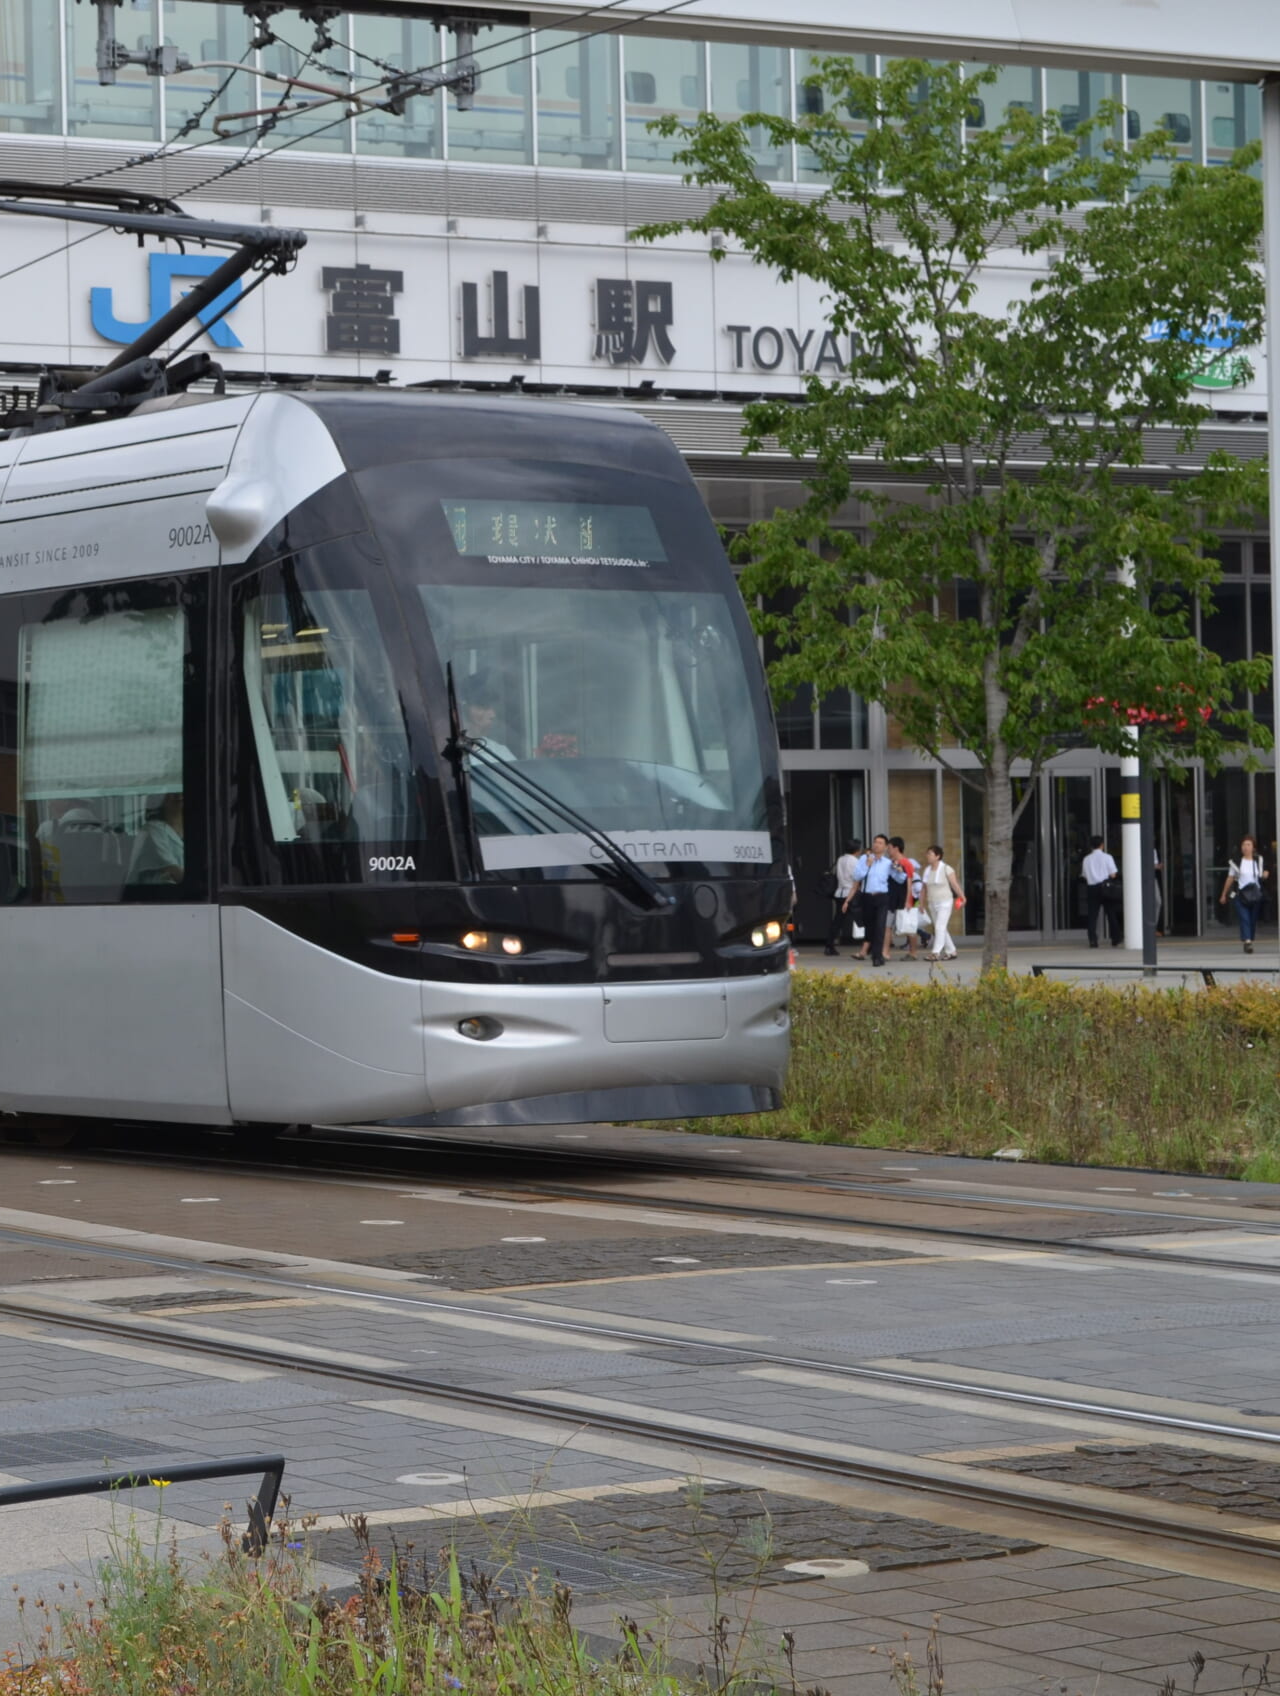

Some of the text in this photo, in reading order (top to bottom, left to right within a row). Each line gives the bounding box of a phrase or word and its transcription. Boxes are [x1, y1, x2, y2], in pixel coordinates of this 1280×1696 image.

[91, 253, 243, 348] JR
[322, 264, 677, 365] 富山駅
[169, 523, 211, 549] 9002A
[35, 547, 67, 564] SINCE
[72, 542, 99, 559] 2009
[488, 555, 518, 564] TOYAMA
[519, 556, 535, 564] CITY
[541, 556, 570, 565] TOYAMA
[571, 556, 600, 565] CHIHOU
[733, 845, 764, 859] 9002A
[369, 857, 415, 871] 9002A
